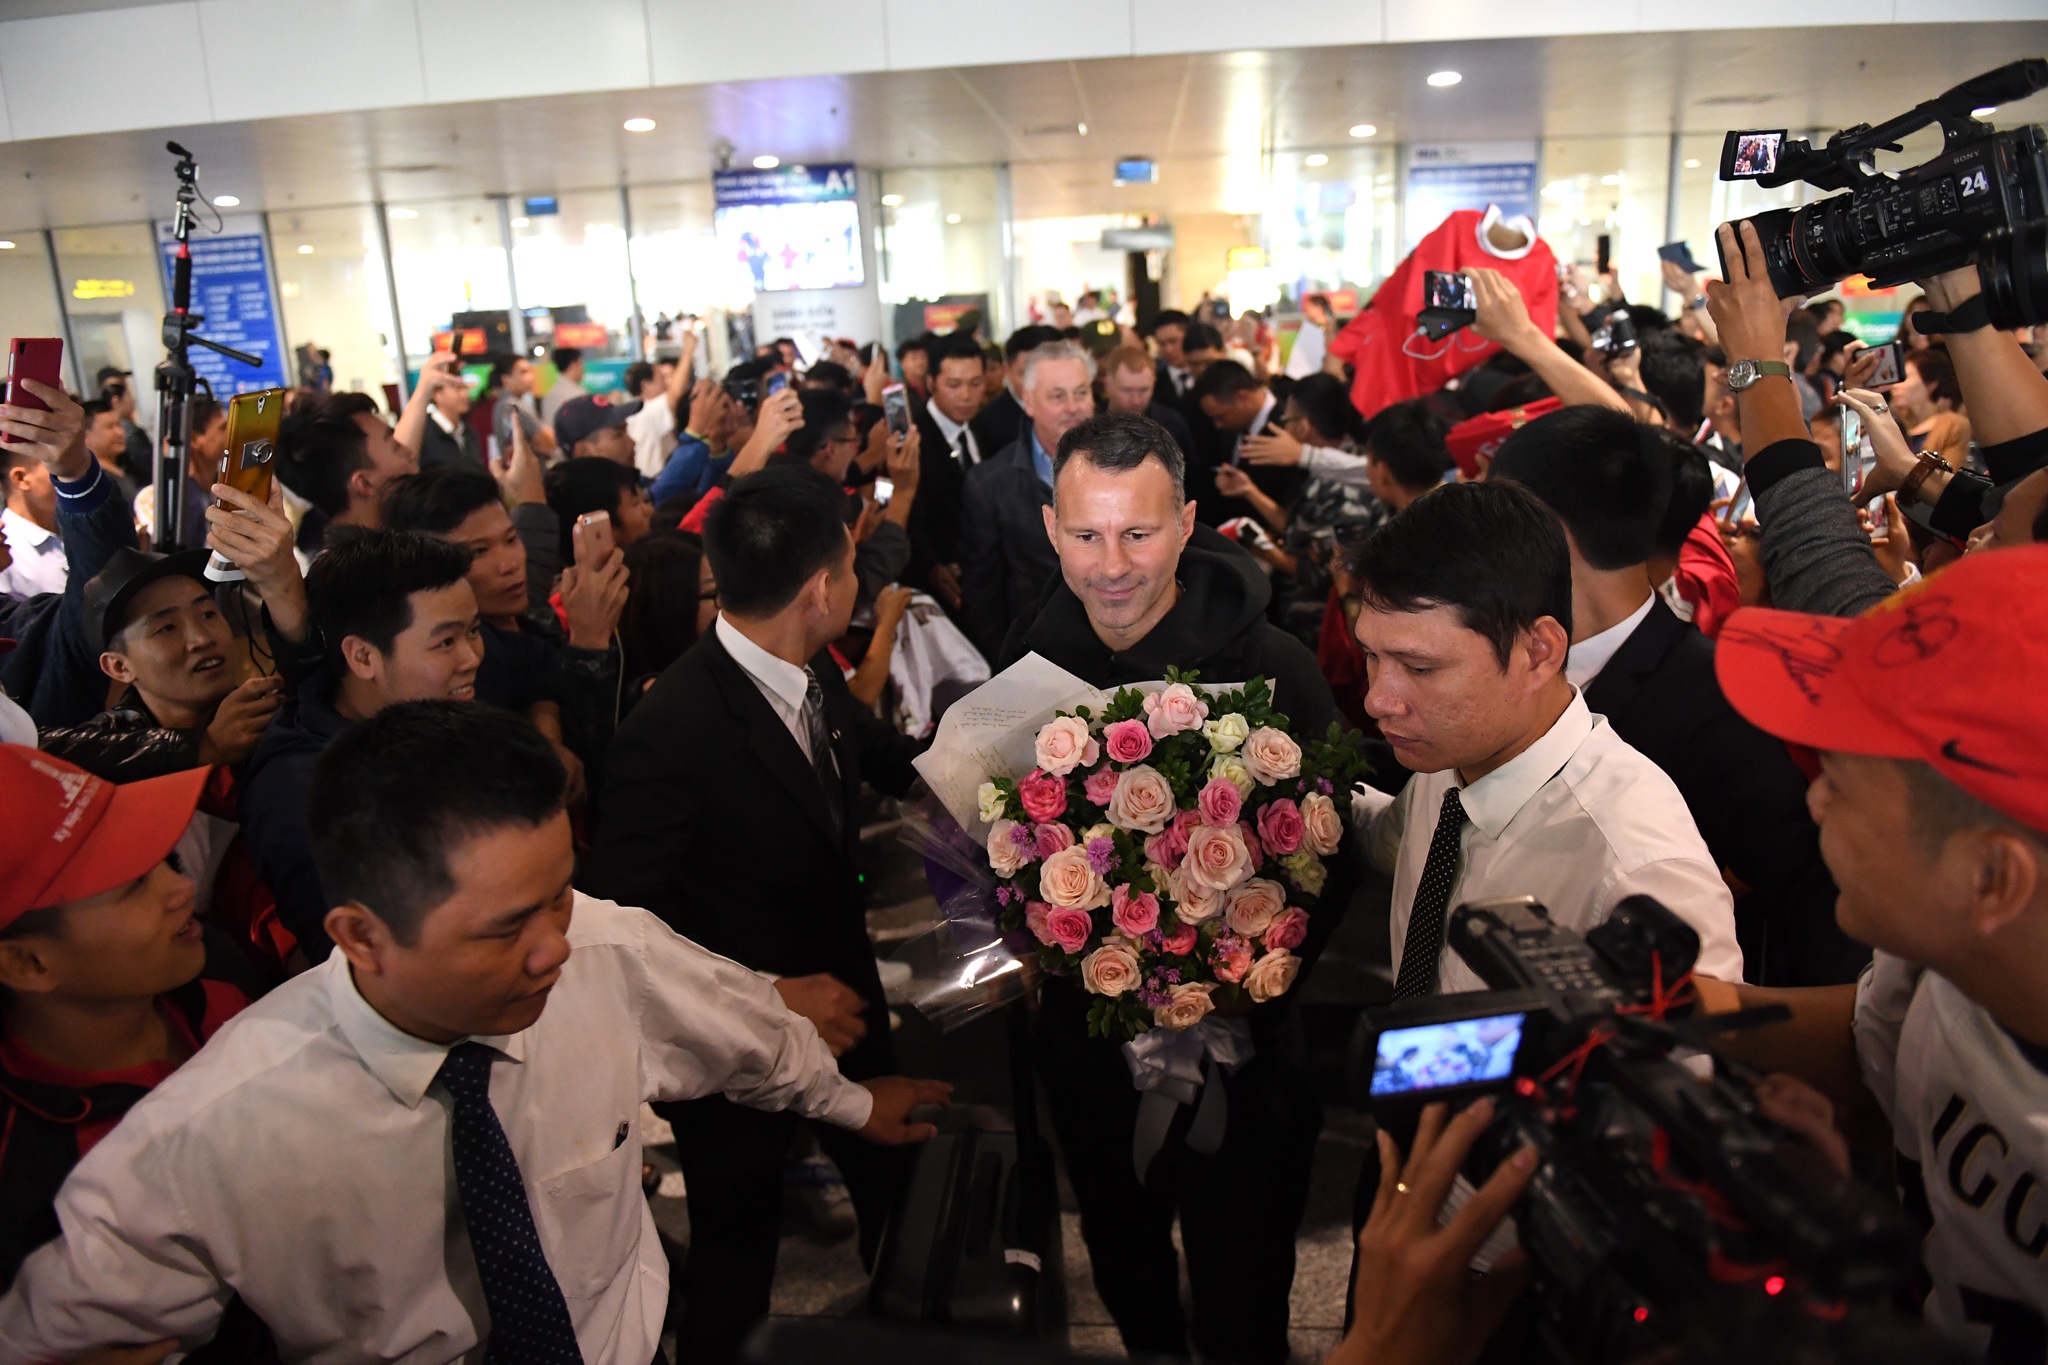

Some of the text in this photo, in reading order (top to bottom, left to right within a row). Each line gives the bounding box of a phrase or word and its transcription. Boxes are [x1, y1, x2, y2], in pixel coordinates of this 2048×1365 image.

[1953, 150, 1980, 165] SONY
[825, 169, 856, 194] A1
[1960, 171, 1986, 197] 24
